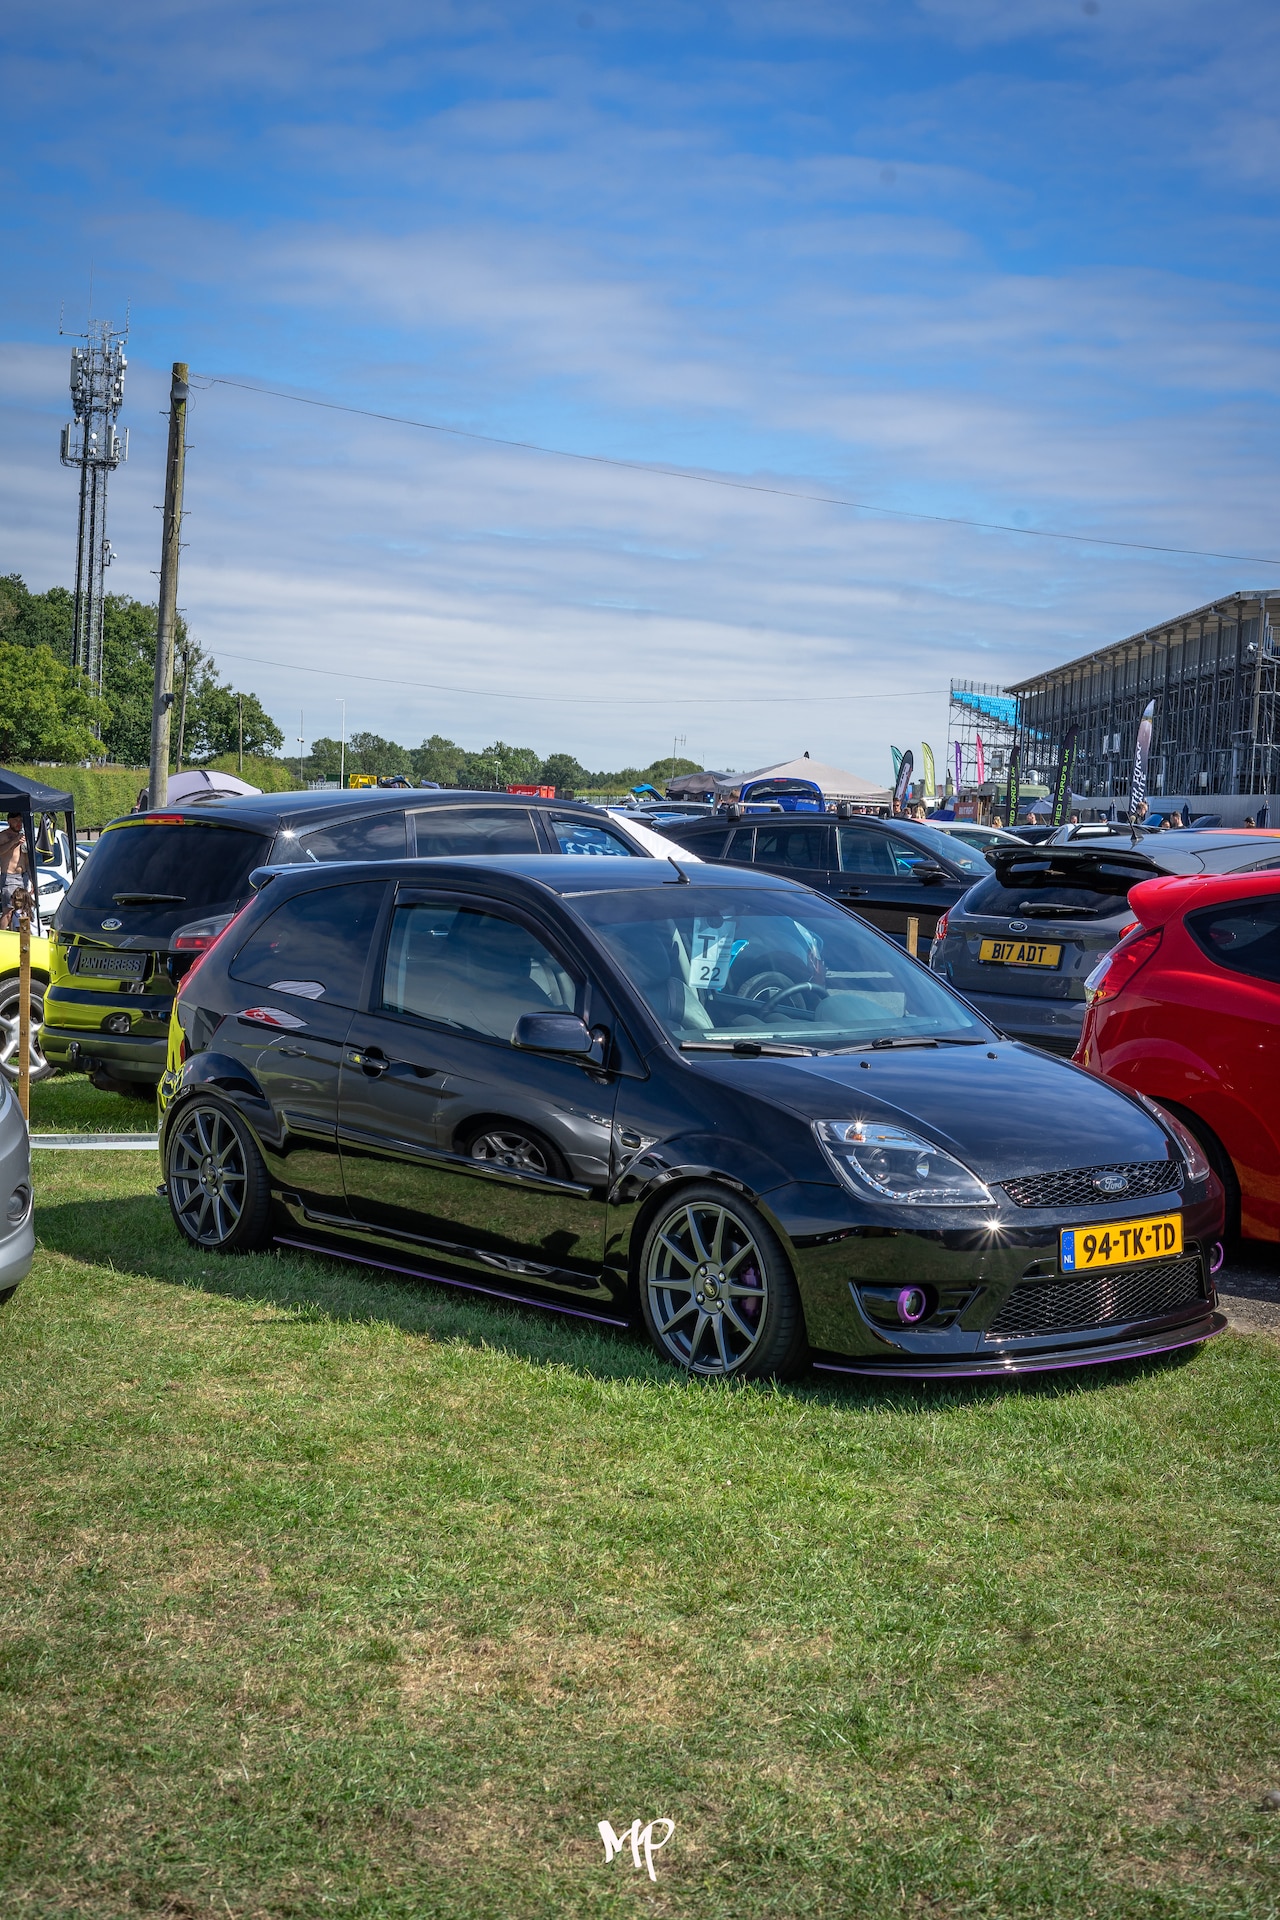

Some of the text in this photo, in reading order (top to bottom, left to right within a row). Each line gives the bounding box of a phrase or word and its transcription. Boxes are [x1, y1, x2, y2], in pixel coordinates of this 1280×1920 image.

[1011, 766, 1016, 778] UK
[1054, 749, 1070, 826] FIED FORD'S UK
[697, 935, 716, 958] T
[1016, 944, 1047, 963] ADT
[80, 957, 141, 972] PANTHERESS
[700, 966, 721, 982] 22
[1104, 1176, 1123, 1190] Ford
[1083, 1223, 1175, 1263] 94-TK-TD
[1063, 1255, 1073, 1264] NL
